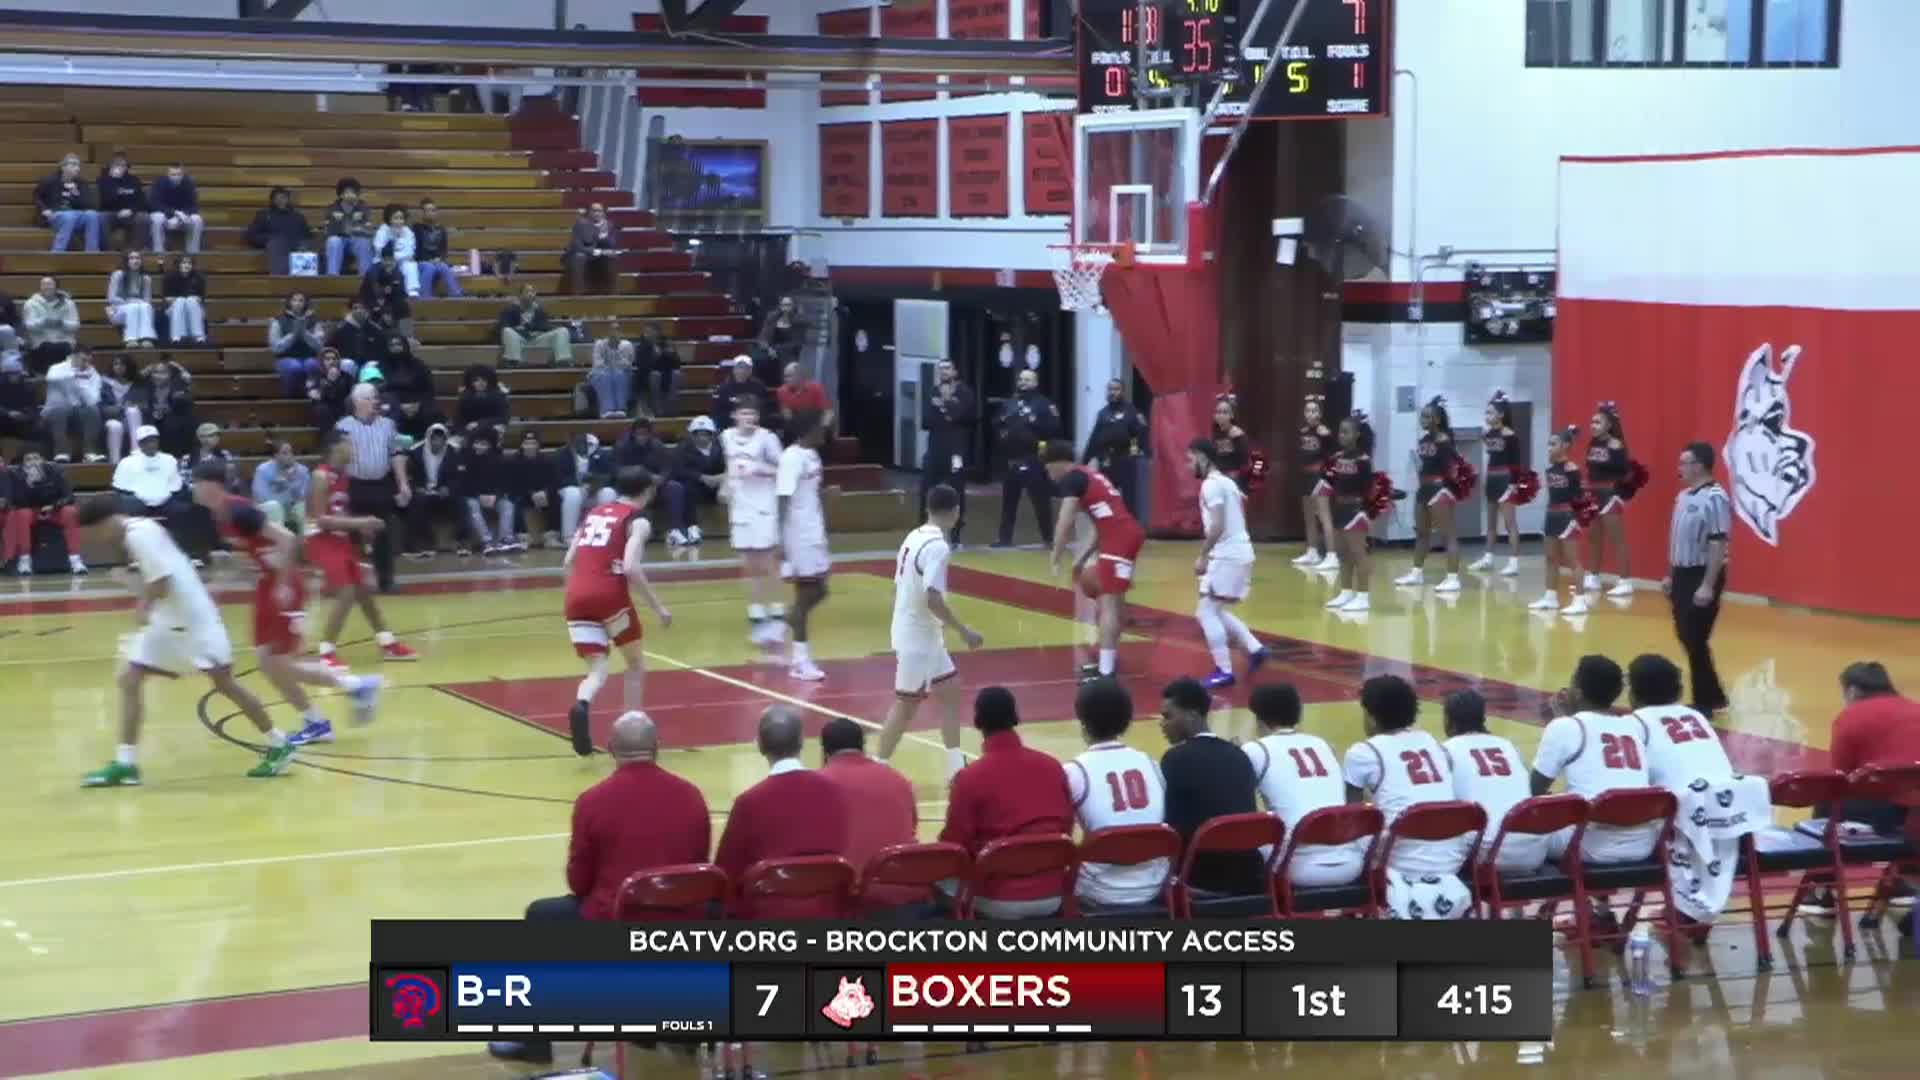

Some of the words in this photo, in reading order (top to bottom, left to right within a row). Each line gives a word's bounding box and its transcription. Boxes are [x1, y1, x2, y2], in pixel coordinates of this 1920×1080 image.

[1286, 61, 1308, 93] 5
[578, 514, 618, 547] 35
[1660, 714, 1711, 745] 23
[1287, 746, 1329, 778] 11
[1400, 748, 1443, 785] 21
[1469, 747, 1512, 777] 15
[1601, 732, 1642, 770] 20
[1105, 768, 1150, 813] 10
